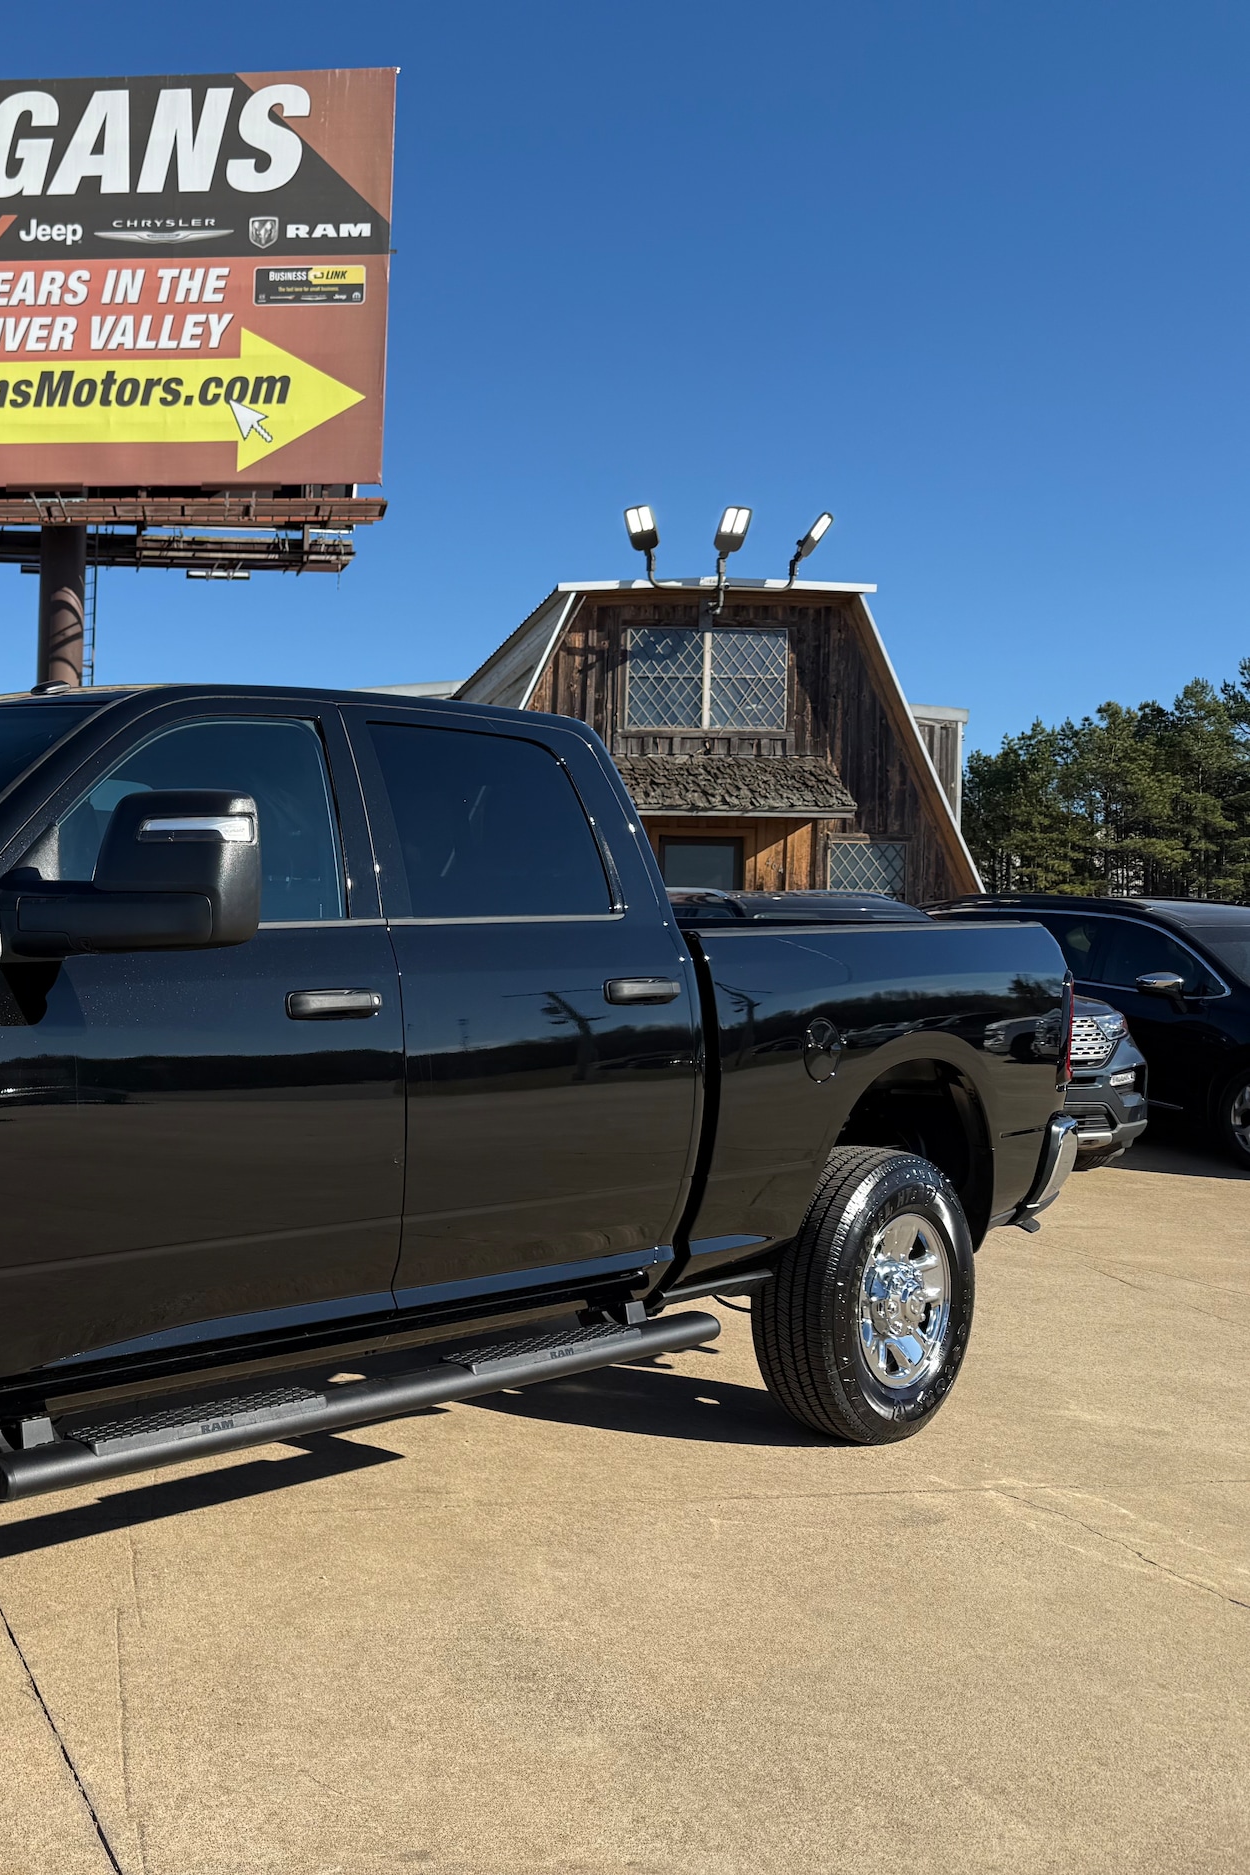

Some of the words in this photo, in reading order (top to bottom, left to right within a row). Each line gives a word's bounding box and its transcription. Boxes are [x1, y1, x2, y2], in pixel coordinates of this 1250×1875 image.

[112, 218, 216, 228] CHRYSLER
[286, 223, 371, 238] RAM
[19, 218, 82, 245] Jeep
[269, 271, 307, 281] BUSINESS
[325, 270, 347, 280] LINK
[100, 268, 143, 304] IN
[157, 267, 228, 302] THE
[90, 313, 234, 351] VALLEY
[201, 1419, 234, 1434] RAM
